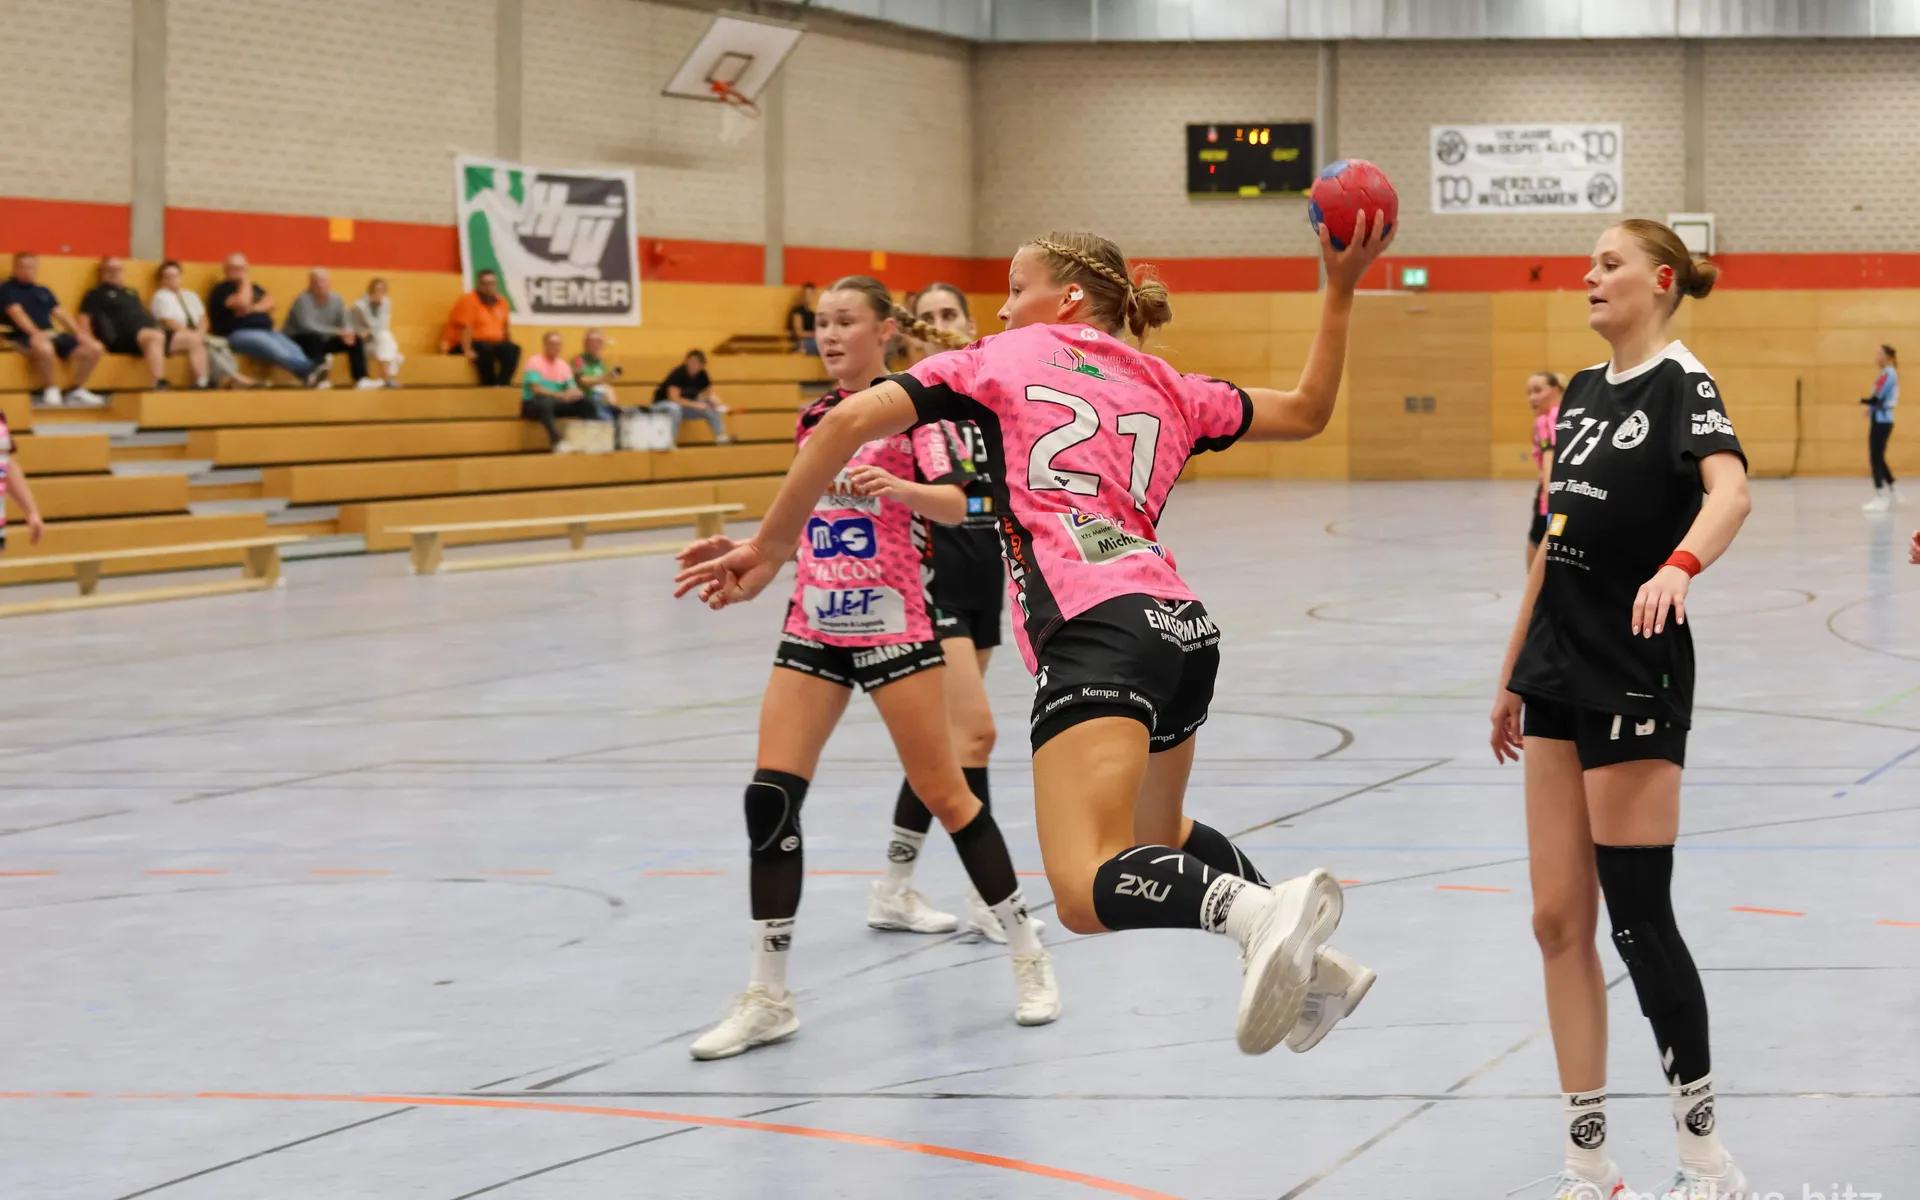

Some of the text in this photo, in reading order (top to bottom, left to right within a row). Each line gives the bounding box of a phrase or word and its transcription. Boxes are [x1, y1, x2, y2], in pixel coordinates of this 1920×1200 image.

[525, 277, 630, 307] HEMER
[1024, 384, 1161, 515] 21
[1558, 417, 1609, 466] 73
[1565, 478, 1608, 500] Tiefbau
[1045, 693, 1073, 713] Kempa
[1082, 687, 1119, 699] Kempa
[1114, 873, 1172, 903] 2XU
